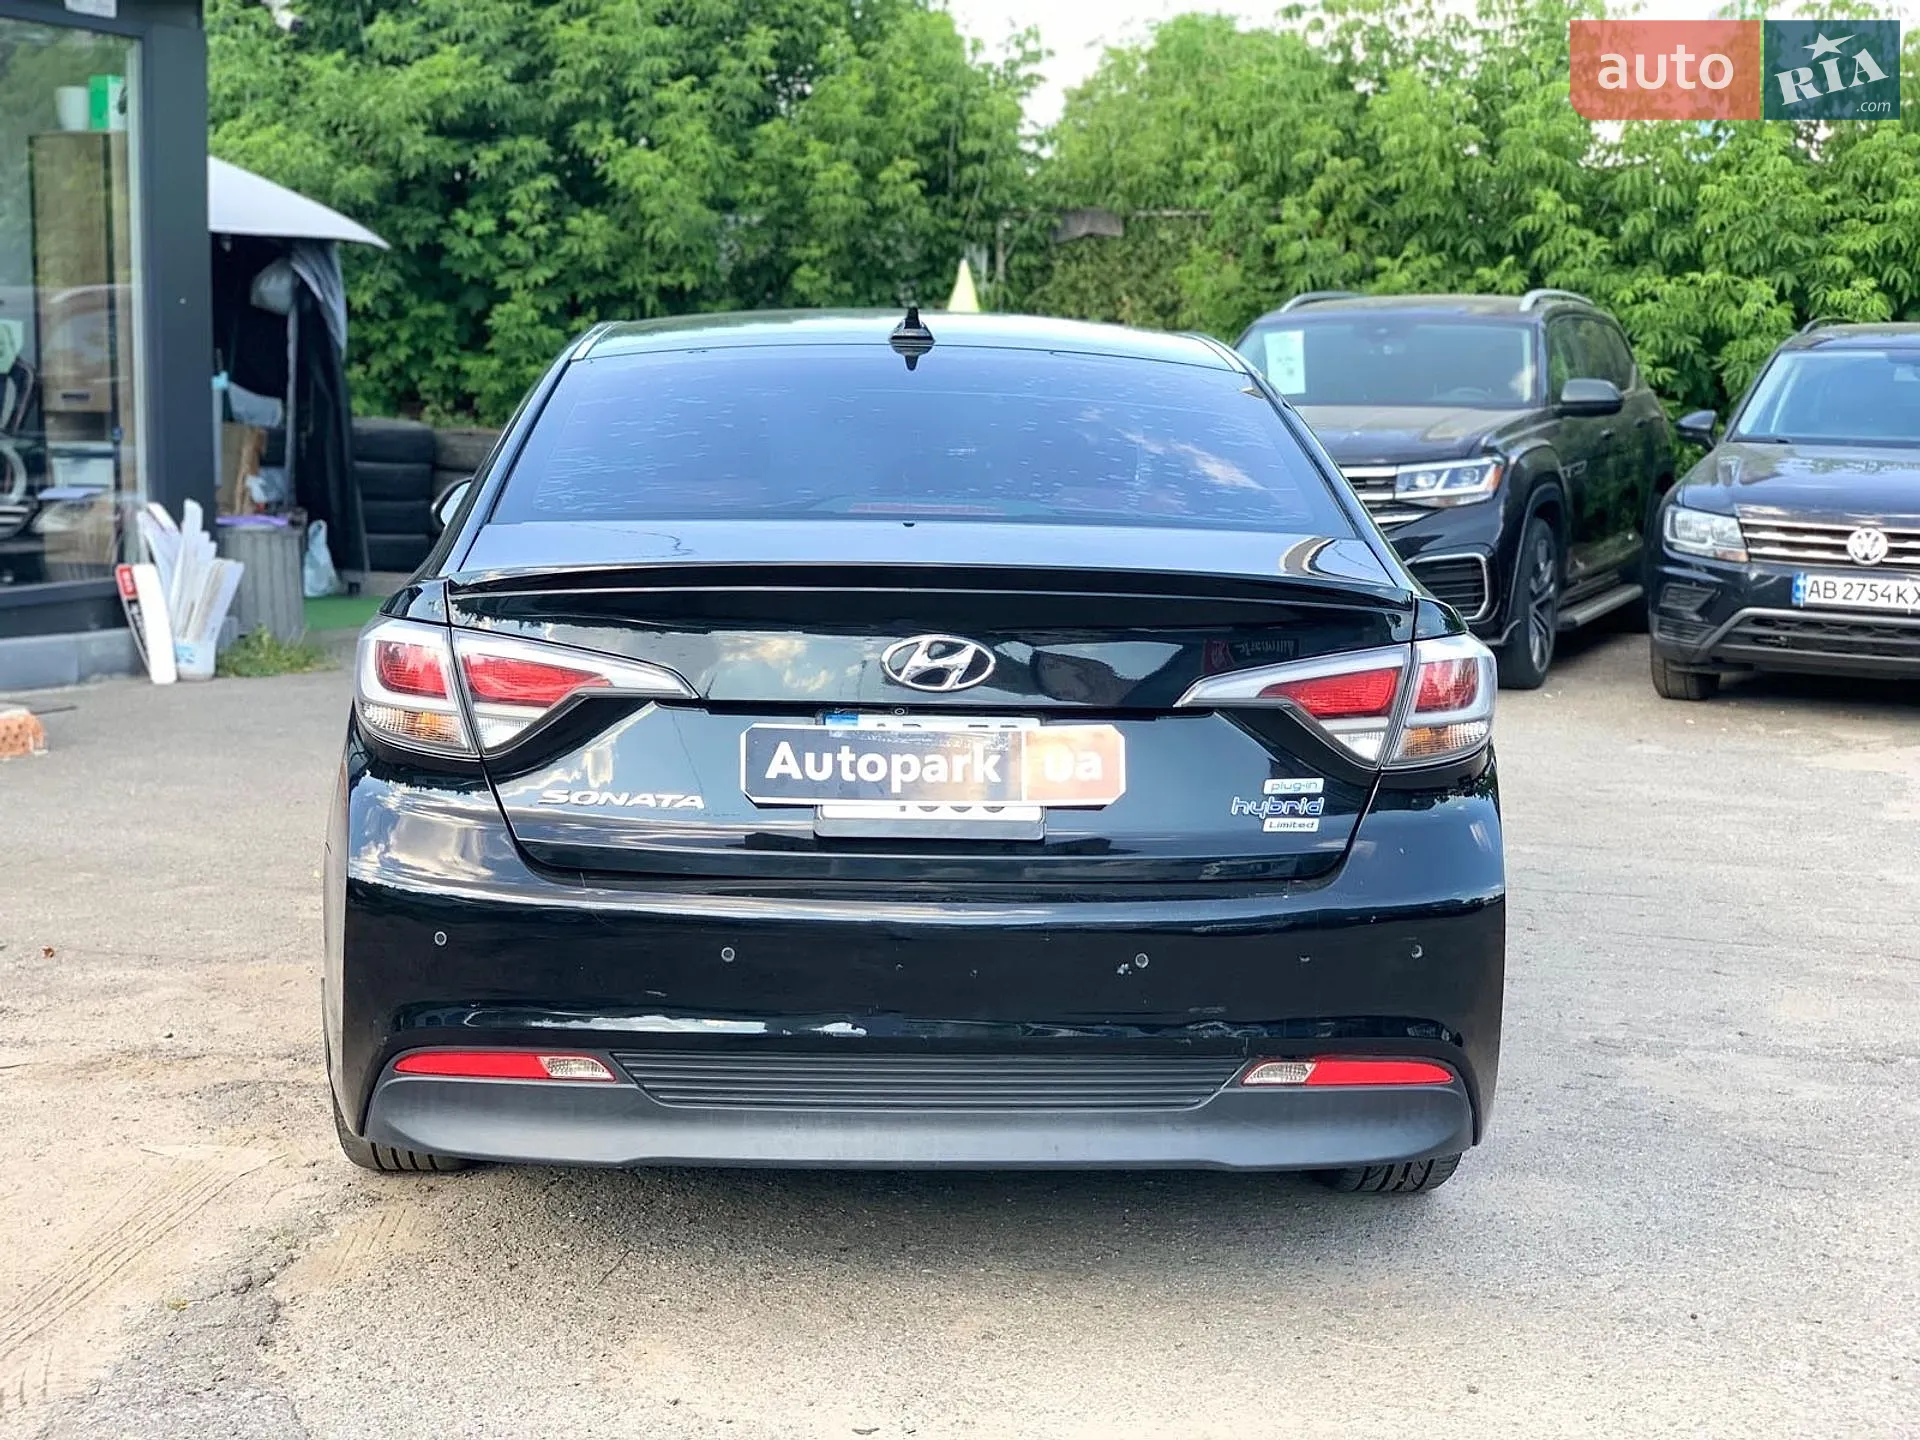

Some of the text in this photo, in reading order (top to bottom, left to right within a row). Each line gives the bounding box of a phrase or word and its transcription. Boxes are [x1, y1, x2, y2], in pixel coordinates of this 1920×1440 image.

[764, 740, 1002, 793] Autopark
[1270, 781, 1318, 792] plug-in
[537, 788, 705, 810] SONATA
[1230, 796, 1325, 820] hybrid
[1268, 821, 1315, 829] Limited
